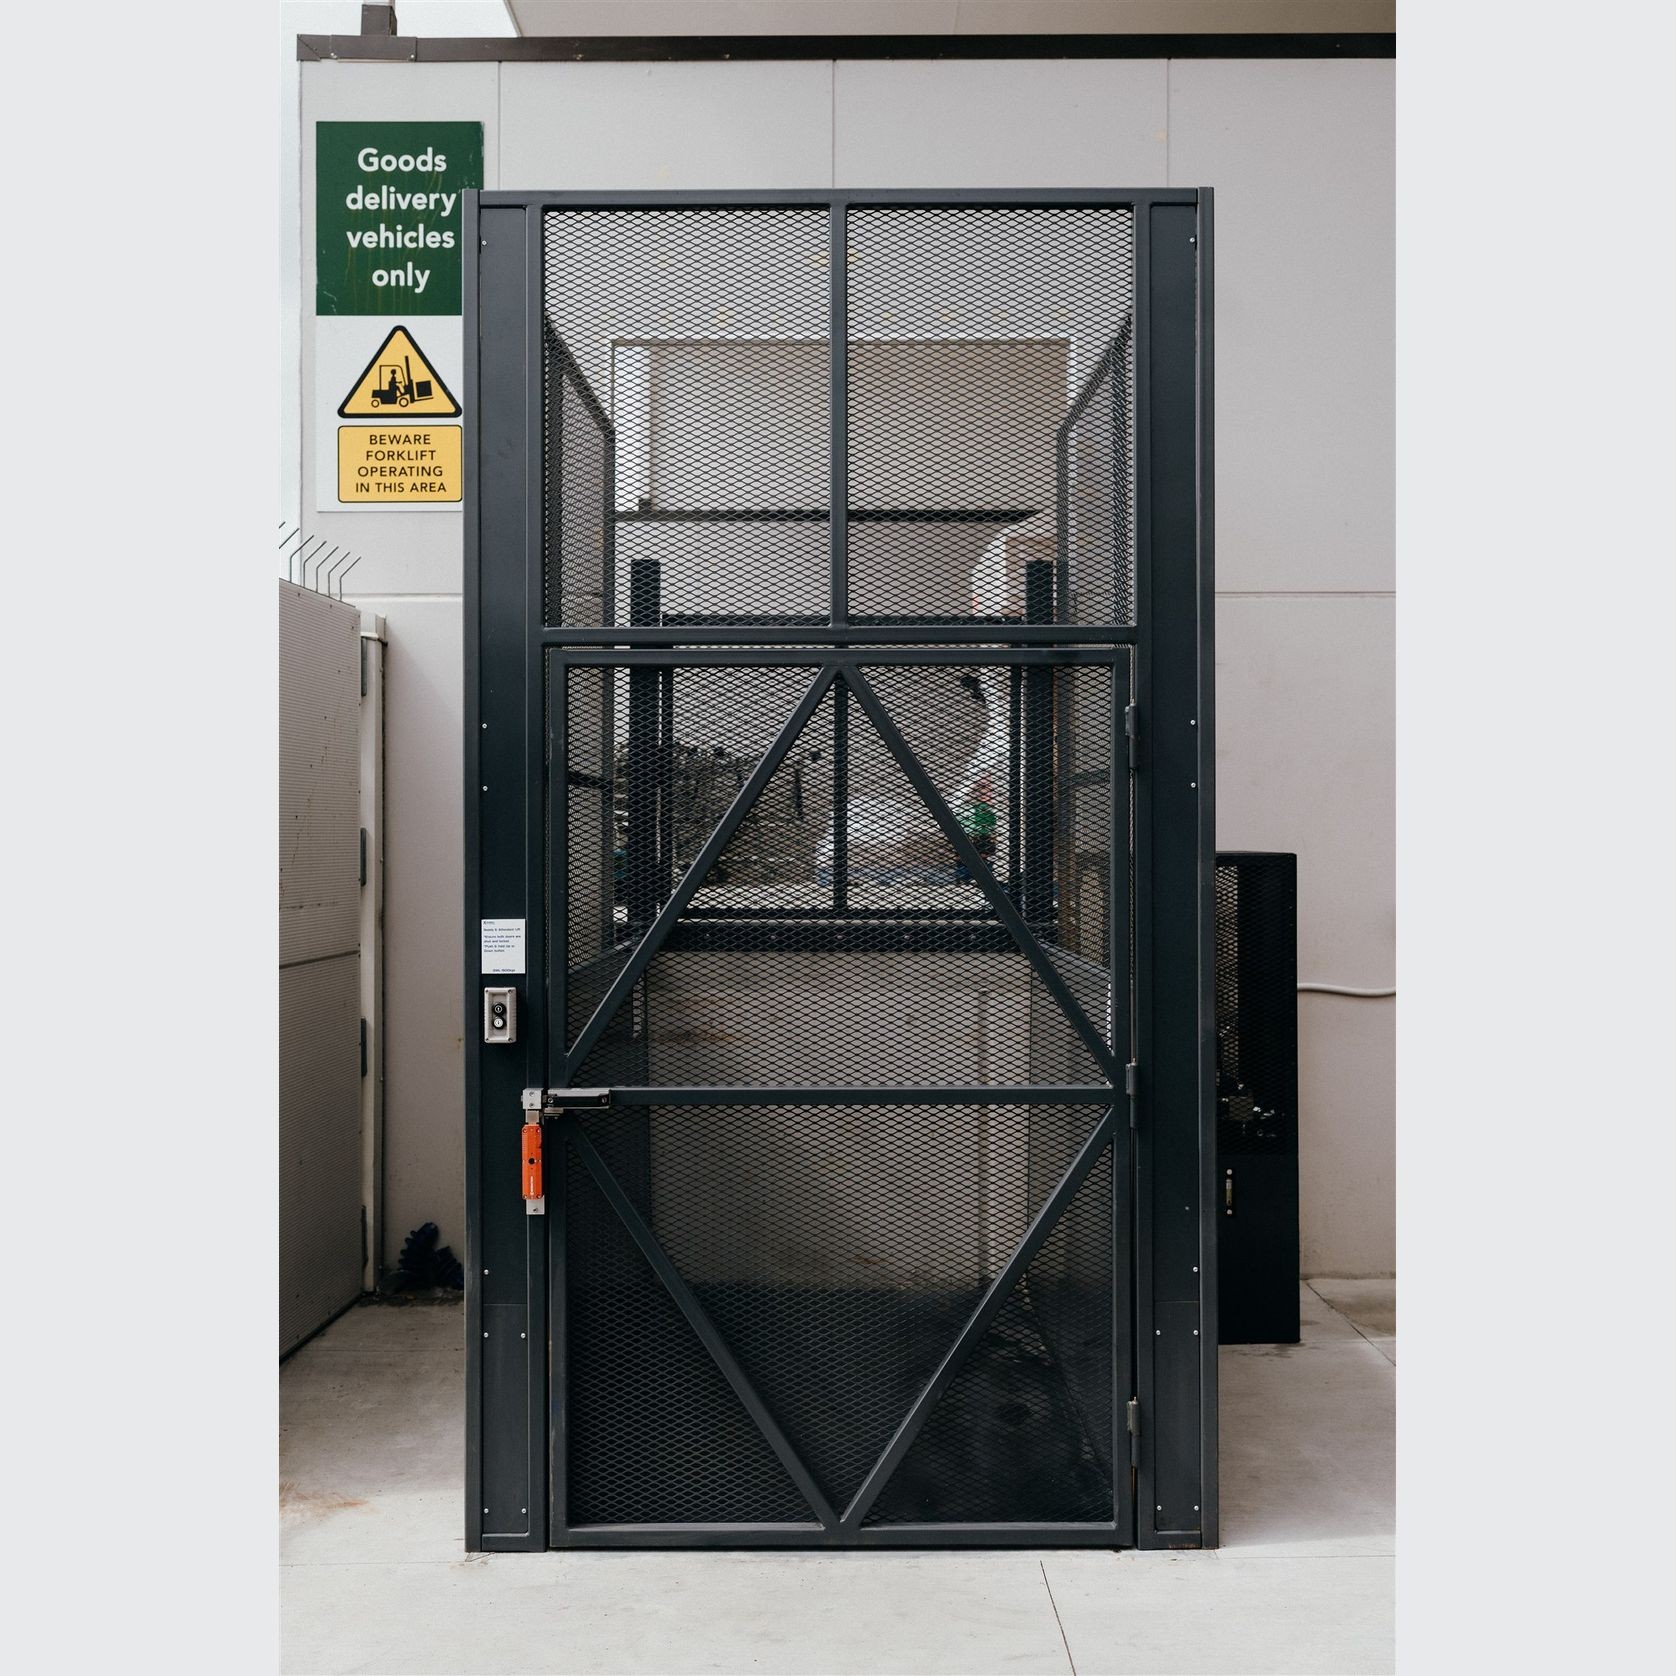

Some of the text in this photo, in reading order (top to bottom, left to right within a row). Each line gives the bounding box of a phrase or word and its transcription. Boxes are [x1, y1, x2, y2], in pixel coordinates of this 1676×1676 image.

[357, 147, 447, 172] Goods
[345, 186, 457, 217] delivery
[346, 224, 455, 249] vehicles
[372, 262, 431, 294] only
[369, 433, 431, 446] BEWARE
[366, 449, 437, 462] FORKLIFT
[357, 465, 443, 478] OPERATING
[355, 481, 447, 493] IN THIS AREA
